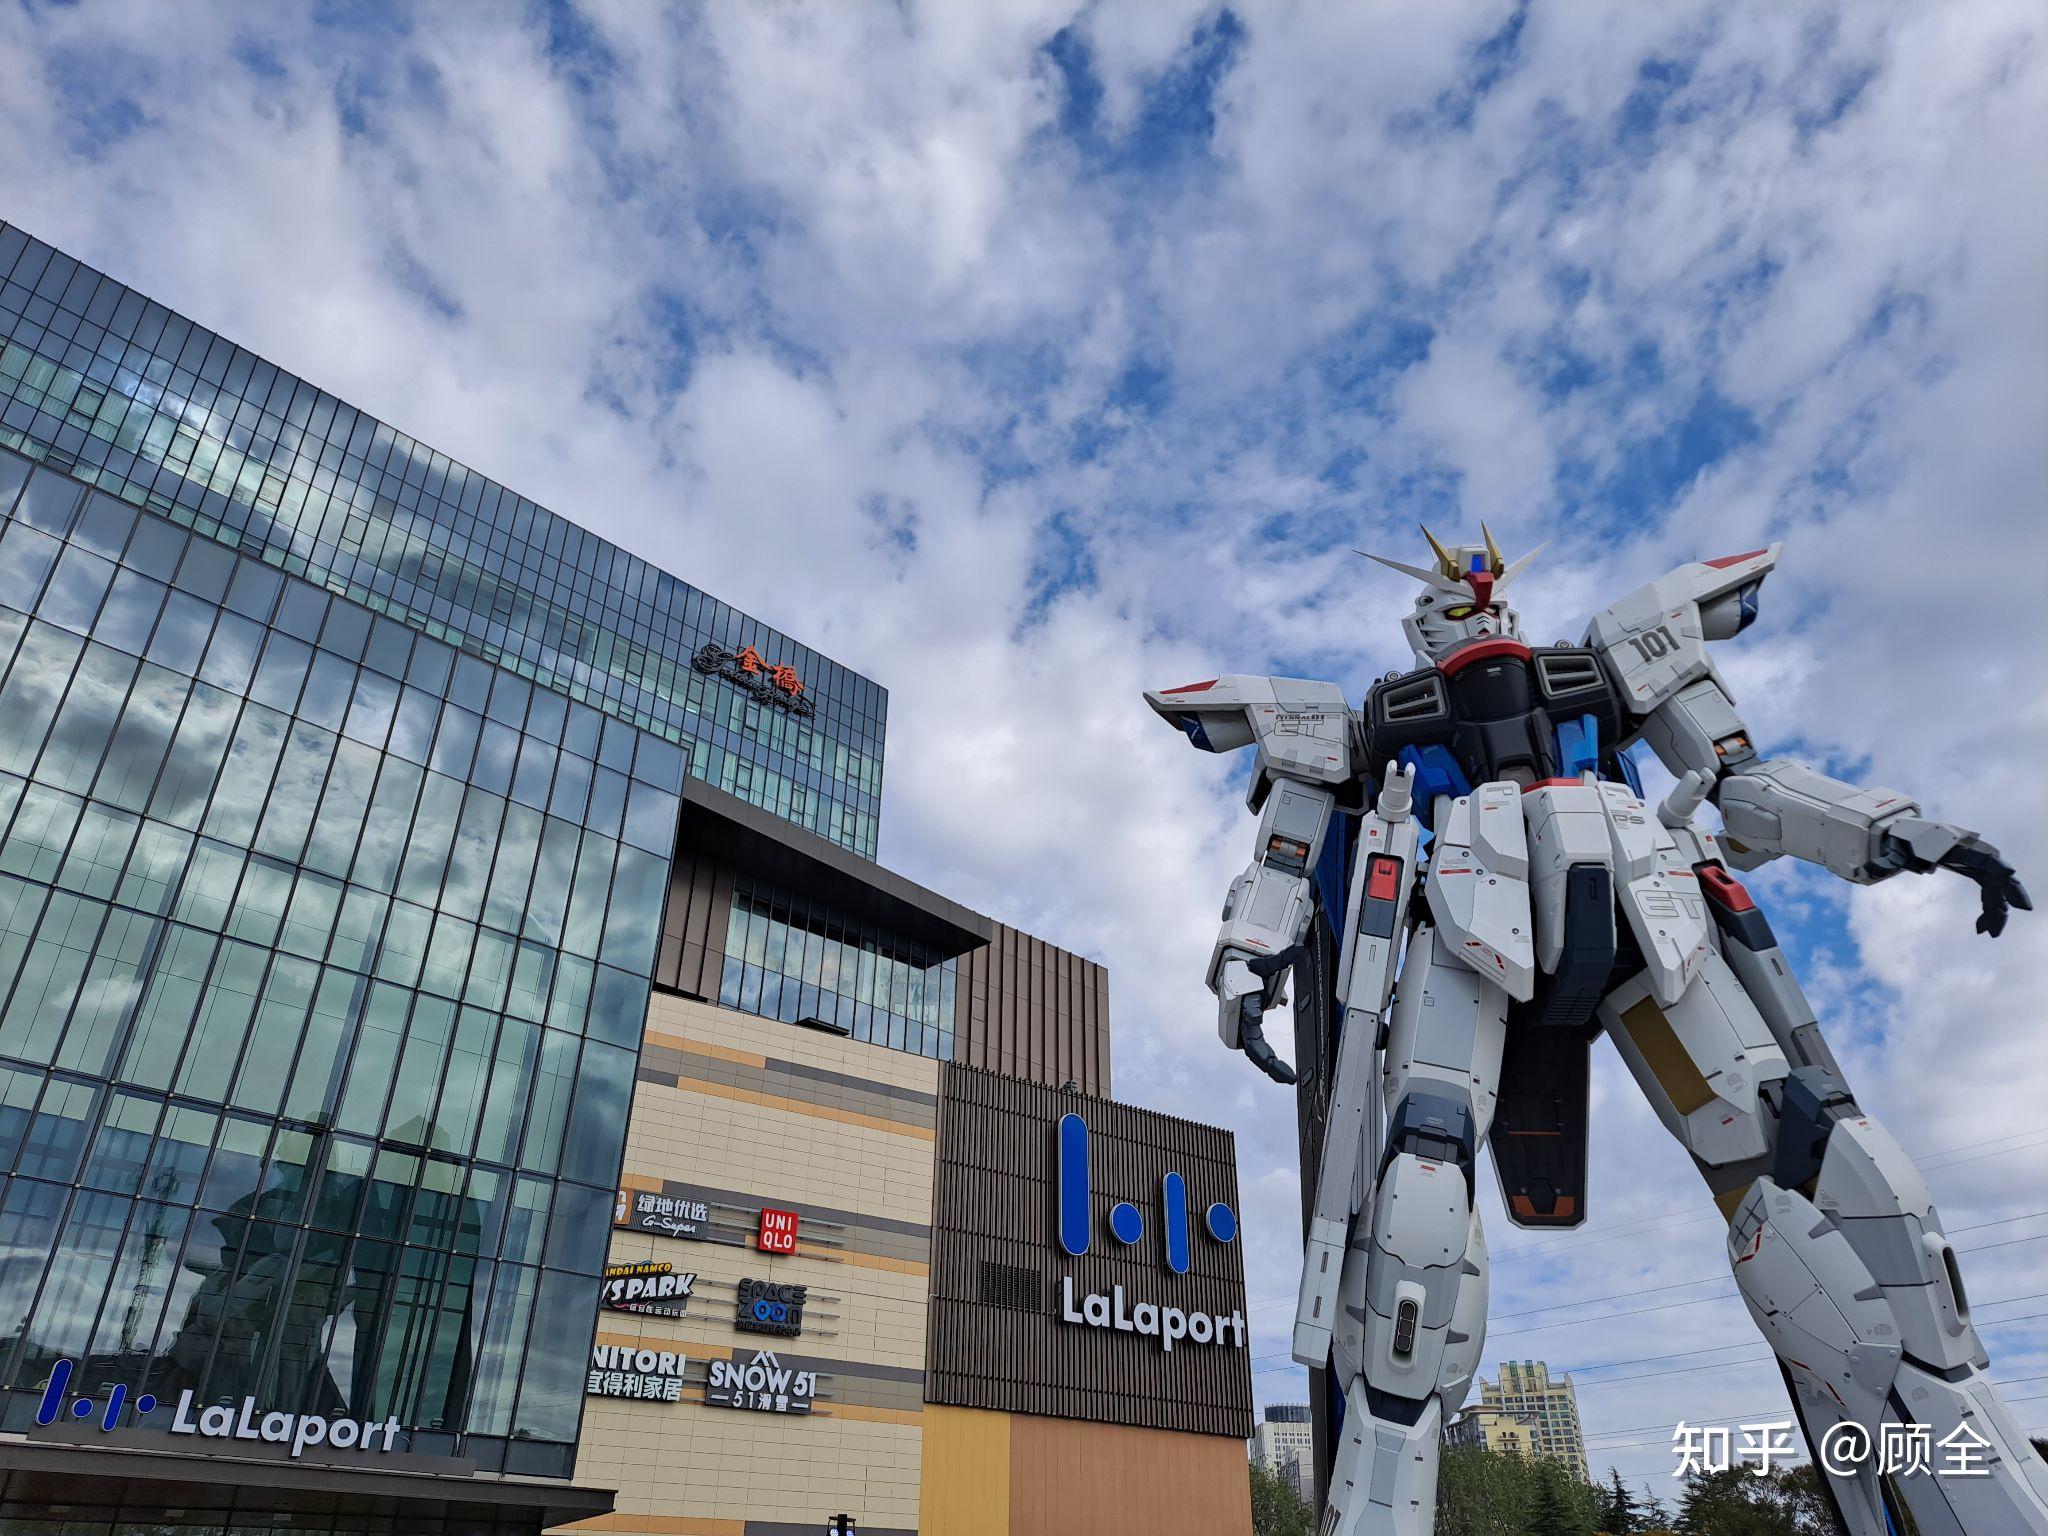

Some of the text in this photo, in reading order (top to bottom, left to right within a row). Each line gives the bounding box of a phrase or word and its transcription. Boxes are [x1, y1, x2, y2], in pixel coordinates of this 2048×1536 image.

[1628, 625, 1681, 663] 101
[637, 1194, 708, 1222] 绿地优选
[765, 1212, 793, 1230] UNI
[642, 1215, 696, 1238] G-Super
[763, 1231, 793, 1249] QLO
[636, 1262, 672, 1274] NAMCO
[1063, 1275, 1245, 1352] LaLaport
[591, 1344, 687, 1376] NITORI
[587, 1369, 683, 1402] 宜得利家居
[709, 1360, 816, 1398] SNOW 51
[171, 1388, 401, 1458] LaLaport
